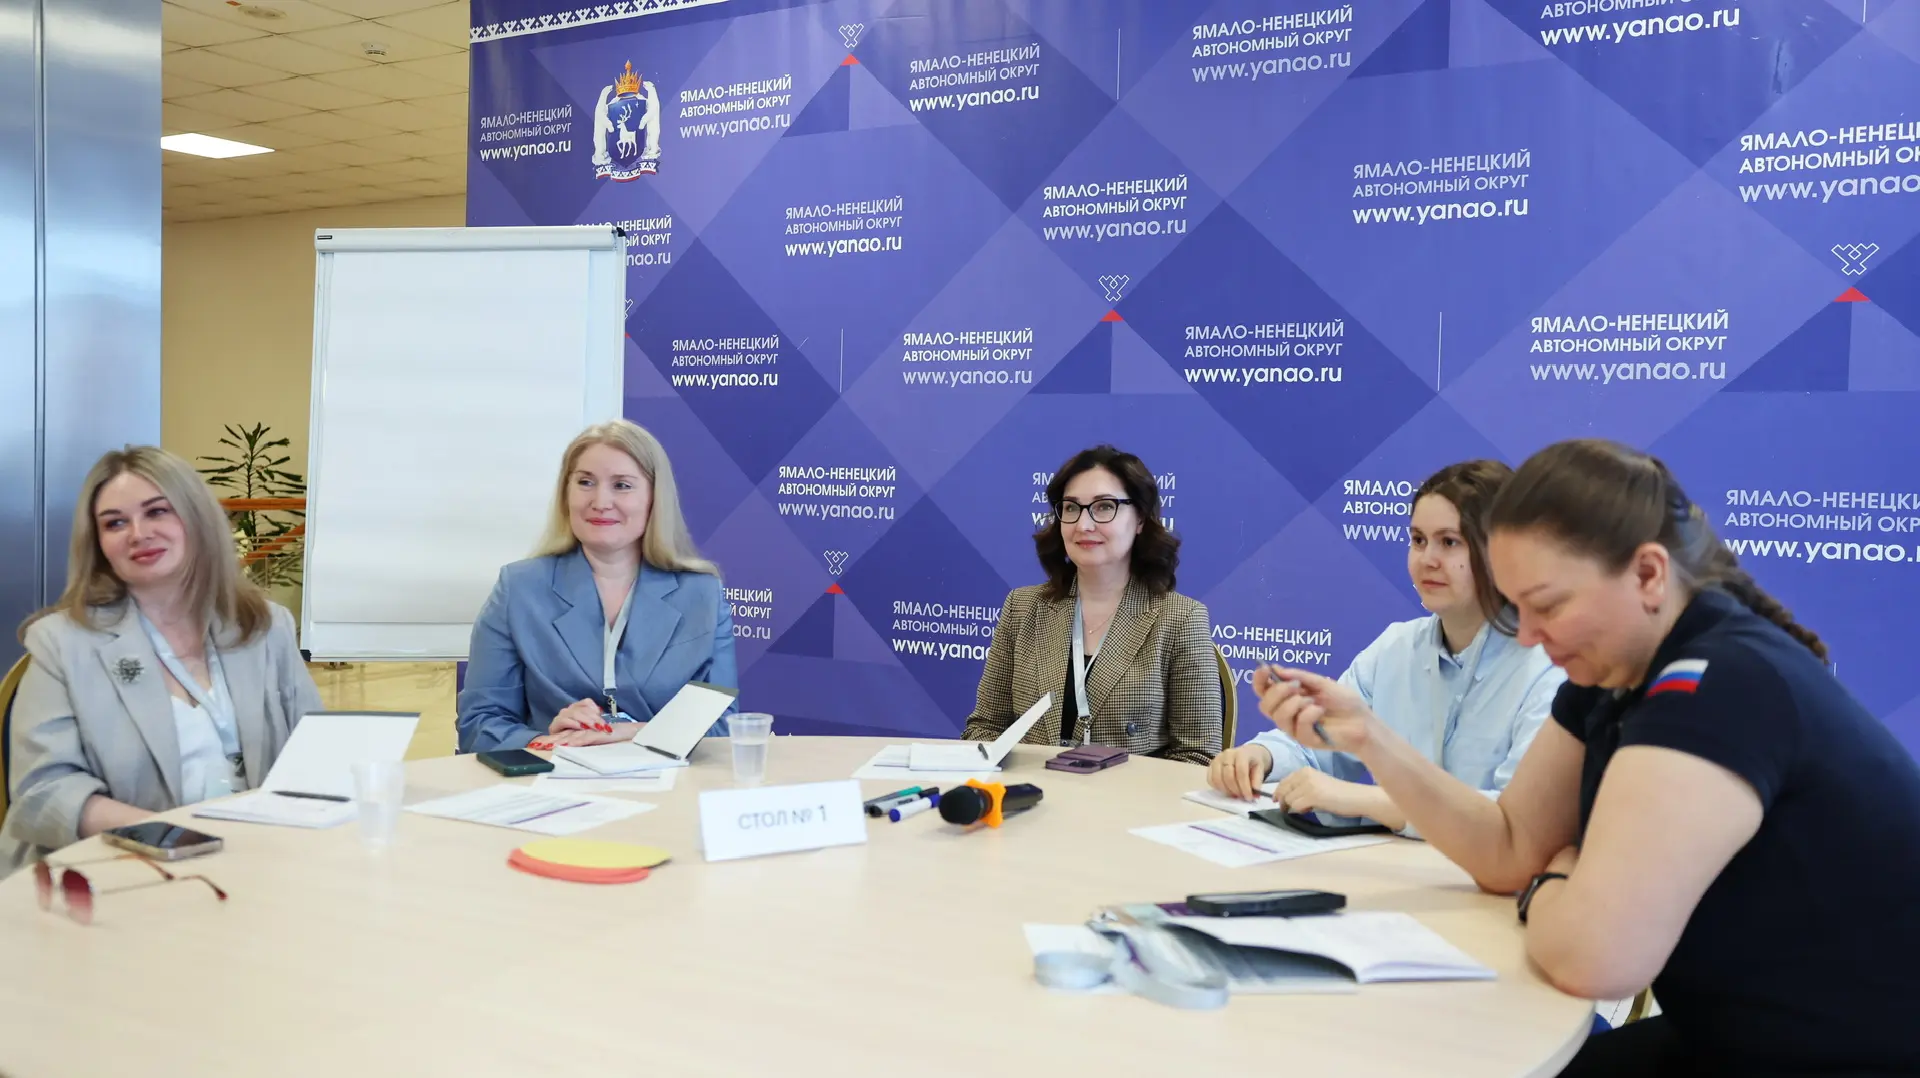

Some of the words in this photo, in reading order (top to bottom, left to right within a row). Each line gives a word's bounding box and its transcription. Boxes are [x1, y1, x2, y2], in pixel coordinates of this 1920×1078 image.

[1193, 4, 1352, 39] ЯМАЛО-НЕНЕЦКИЙ
[1541, 8, 1739, 45] www.yanao.ru
[1192, 32, 1298, 57] АВТОНОМНЫЙ
[1303, 28, 1352, 45] ОКРУГ
[910, 43, 1039, 73] ЯМАЛО-НЕНЕЦКИЙ
[1192, 52, 1350, 82] www.yanao.ru
[910, 67, 996, 90] АВТОНОМНЫЙ
[1000, 64, 1039, 80] ОКРУГ
[681, 74, 791, 103] ЯМАЛО-НЕНЕЦКИЙ
[910, 86, 1039, 111] www.yanao.ru
[481, 104, 571, 128] ЯМАЛО-НЕНЕЦКИЙ
[680, 97, 754, 118] АВТОНОМНЫЙ
[757, 95, 791, 108] ОКРУГ
[480, 124, 542, 142] АВТОНОМНЫЙ
[544, 122, 571, 135] ОКРУГ
[680, 114, 790, 138] www.yanao.ru
[1741, 122, 1920, 151] ЯМАЛО-НЕНЕЦ
[480, 140, 571, 161] www.yanao.ru
[1739, 145, 1889, 173] АВТОНОМНЫЙ
[1354, 149, 1530, 178] ЯМАЛО-НЕНЕЦКИЙ
[1044, 174, 1187, 199] ЯМАЛО-НЕНЕЦКИЙ
[1353, 175, 1469, 197] АВТОНОМНЫЙ
[1474, 175, 1528, 190] ОКРУГ
[1739, 174, 1920, 203] www.yanao
[786, 196, 902, 219] ЯМАЛО-НЕНЕЦКИЙ
[1043, 197, 1138, 217] АВТОНОМНЫЙ
[1143, 196, 1187, 211] ОКРУГ
[1353, 199, 1528, 225] www.yanao.ru
[785, 217, 863, 234] АВТОНОМНЫЙ
[866, 216, 902, 230] ОКРУГ
[1044, 220, 1186, 241] www.yanao.ru
[641, 233, 671, 246] ОКРУГ
[785, 236, 901, 257] www.yanao.ru
[626, 252, 671, 267] nao.ru
[1186, 319, 1343, 339] ЯМАЛО-НЕНЕЦКИЙ
[1532, 309, 1728, 333] ЯМАЛО-НЕНЕЦКИЙ
[673, 335, 778, 351] ЯМАЛО-НЕНЕЦКИЙ
[904, 328, 1032, 345] ЯМАЛО-НЕНЕЦКИЙ
[1530, 334, 1660, 352] АВТОНОМНЫЙ
[1666, 336, 1727, 351] ОКРУГ
[672, 352, 743, 366] АВТОНОМНЫЙ
[745, 354, 778, 364] ОКРУГ
[903, 347, 989, 362] АВТОНОМНЫЙ
[992, 348, 1033, 361] ОКРУГ
[1185, 342, 1289, 357] АВТОНОМНЫЙ
[1294, 343, 1342, 356] ОКРУГ
[672, 371, 778, 389] www.yanao.ru
[903, 369, 1032, 387] www.yanao.ru
[1184, 365, 1342, 386] www.yanao.ru
[1530, 361, 1726, 384] www.yanao.ru
[779, 466, 895, 482] ЯМАЛО-НЕНЕЦКИЙ
[779, 483, 856, 496] АВТОНОМНЫЙ
[859, 485, 895, 497] ОКРУГ
[778, 502, 895, 520] www.yanao.ru
[1342, 501, 1413, 516] АВТОНО
[1725, 513, 1871, 531] АВТОНОМНЫЙ
[1877, 515, 1920, 533] ОКР
[738, 605, 772, 619] ОКРУГ
[893, 600, 1001, 623] ЯМАЛО-НЕНЕЦК
[892, 619, 978, 636] АВТОНОМНЫЙ
[1211, 625, 1332, 646] ЛО-НЕНЕЦКИЙ
[892, 638, 991, 660] www.yana
[1217, 644, 1279, 662] ОМНЫЙ
[1283, 649, 1332, 665] ОКРУГ
[738, 809, 787, 830] СТОЛ
[792, 808, 813, 824] №
[818, 804, 827, 822] 1
